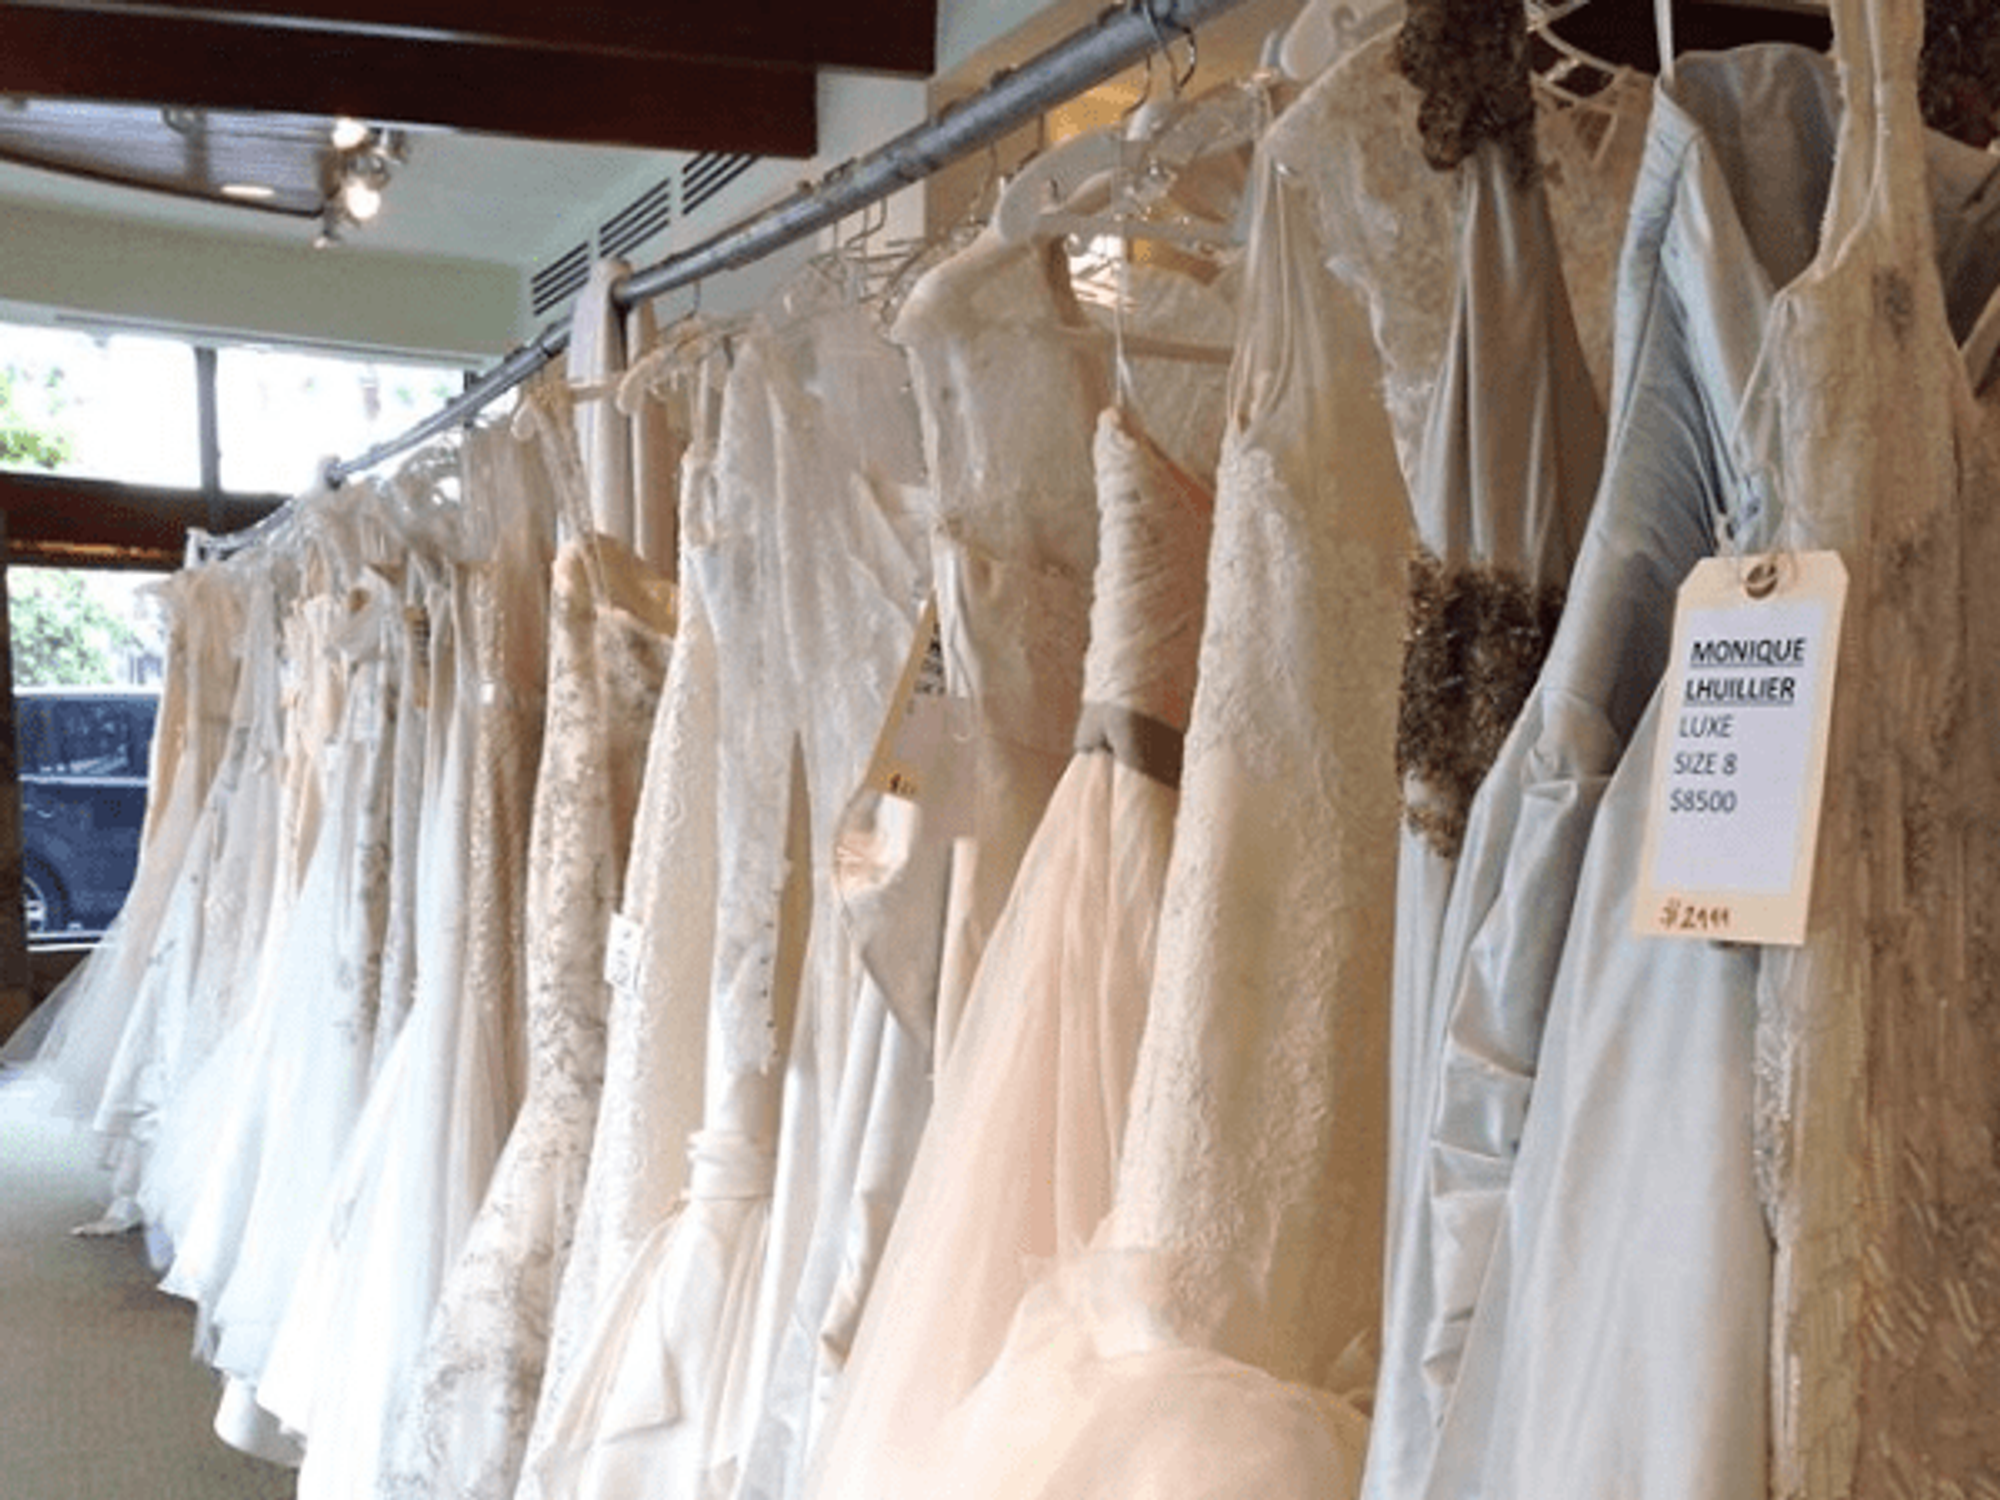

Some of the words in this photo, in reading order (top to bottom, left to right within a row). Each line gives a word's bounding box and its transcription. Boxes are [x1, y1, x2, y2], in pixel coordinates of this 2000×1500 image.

[1690, 638, 1806, 666] MONIQUE
[1684, 676, 1796, 704] LHUILLIER
[1678, 715, 1734, 738] LUXE
[1673, 753, 1717, 775] SIZE
[1722, 754, 1737, 775] 8
[1669, 789, 1737, 814] $8500
